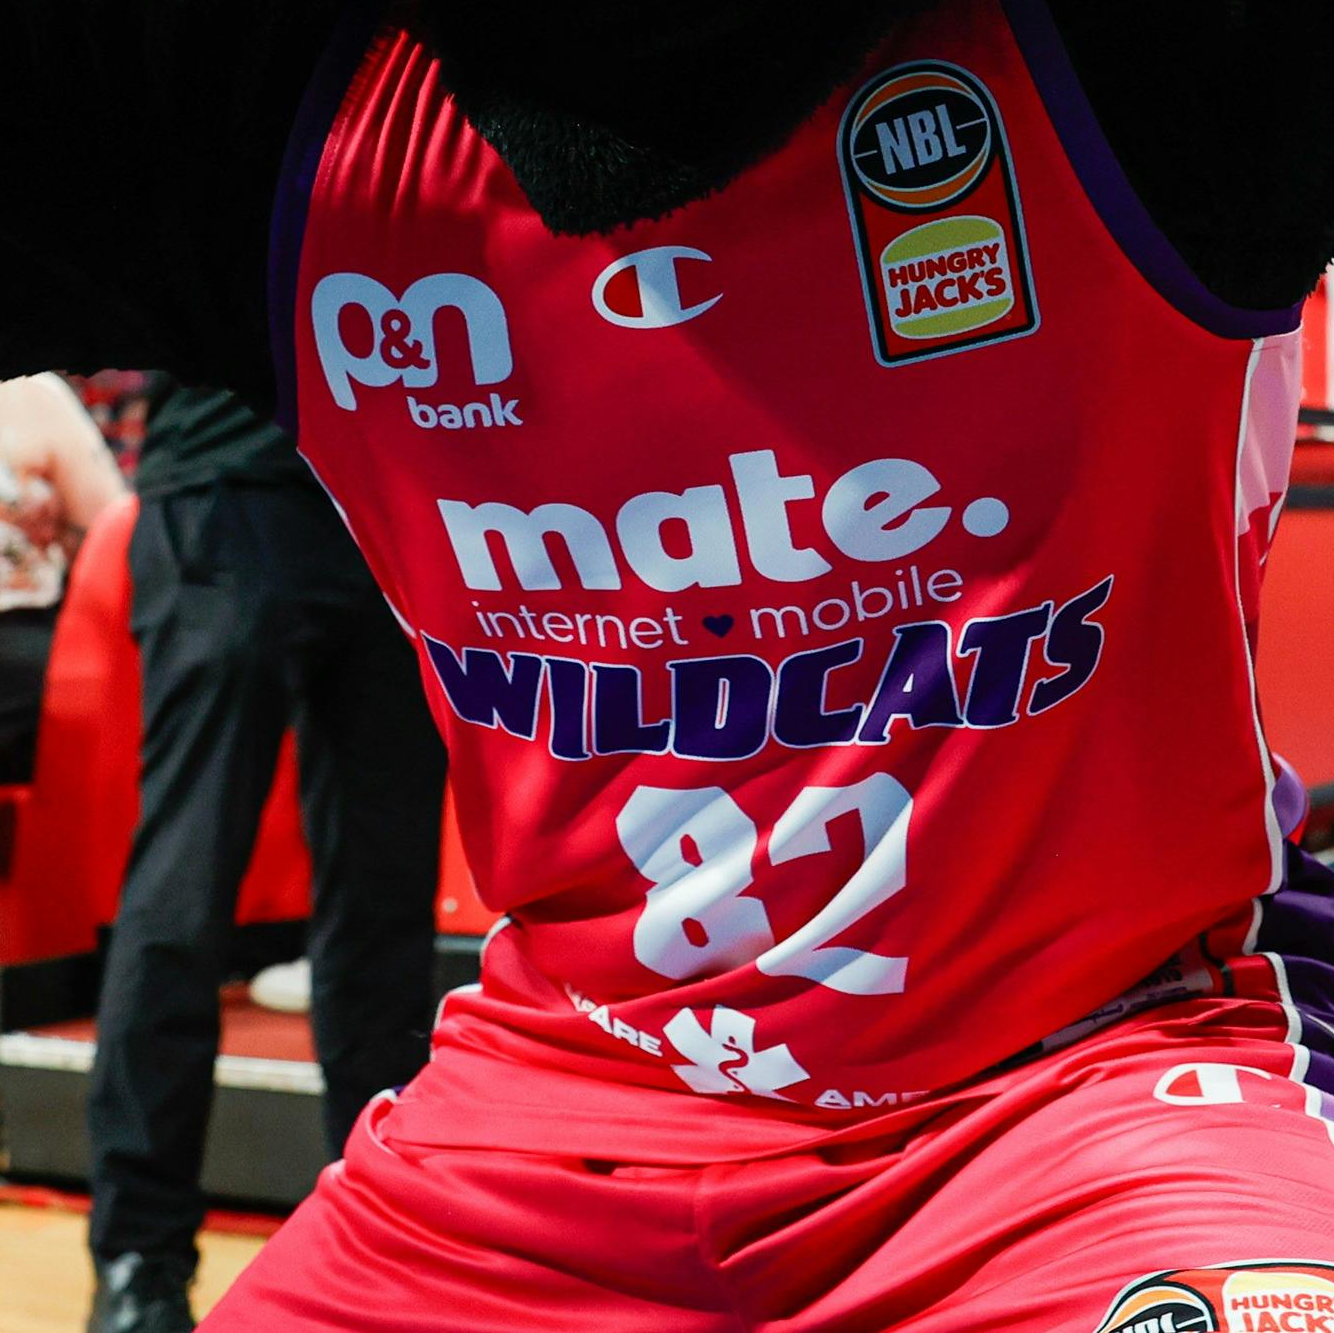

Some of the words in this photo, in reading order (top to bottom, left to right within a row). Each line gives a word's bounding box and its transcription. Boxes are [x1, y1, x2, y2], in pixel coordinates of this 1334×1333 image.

[875, 103, 966, 175] NBL
[887, 242, 1001, 288] HUNGRY
[894, 266, 1008, 318] JACK'S
[406, 393, 524, 430] bank
[436, 448, 1010, 593] mate.
[471, 601, 689, 650] internet
[749, 566, 964, 640] mobile
[420, 574, 1114, 762] WILDCATS
[616, 771, 913, 995] 82
